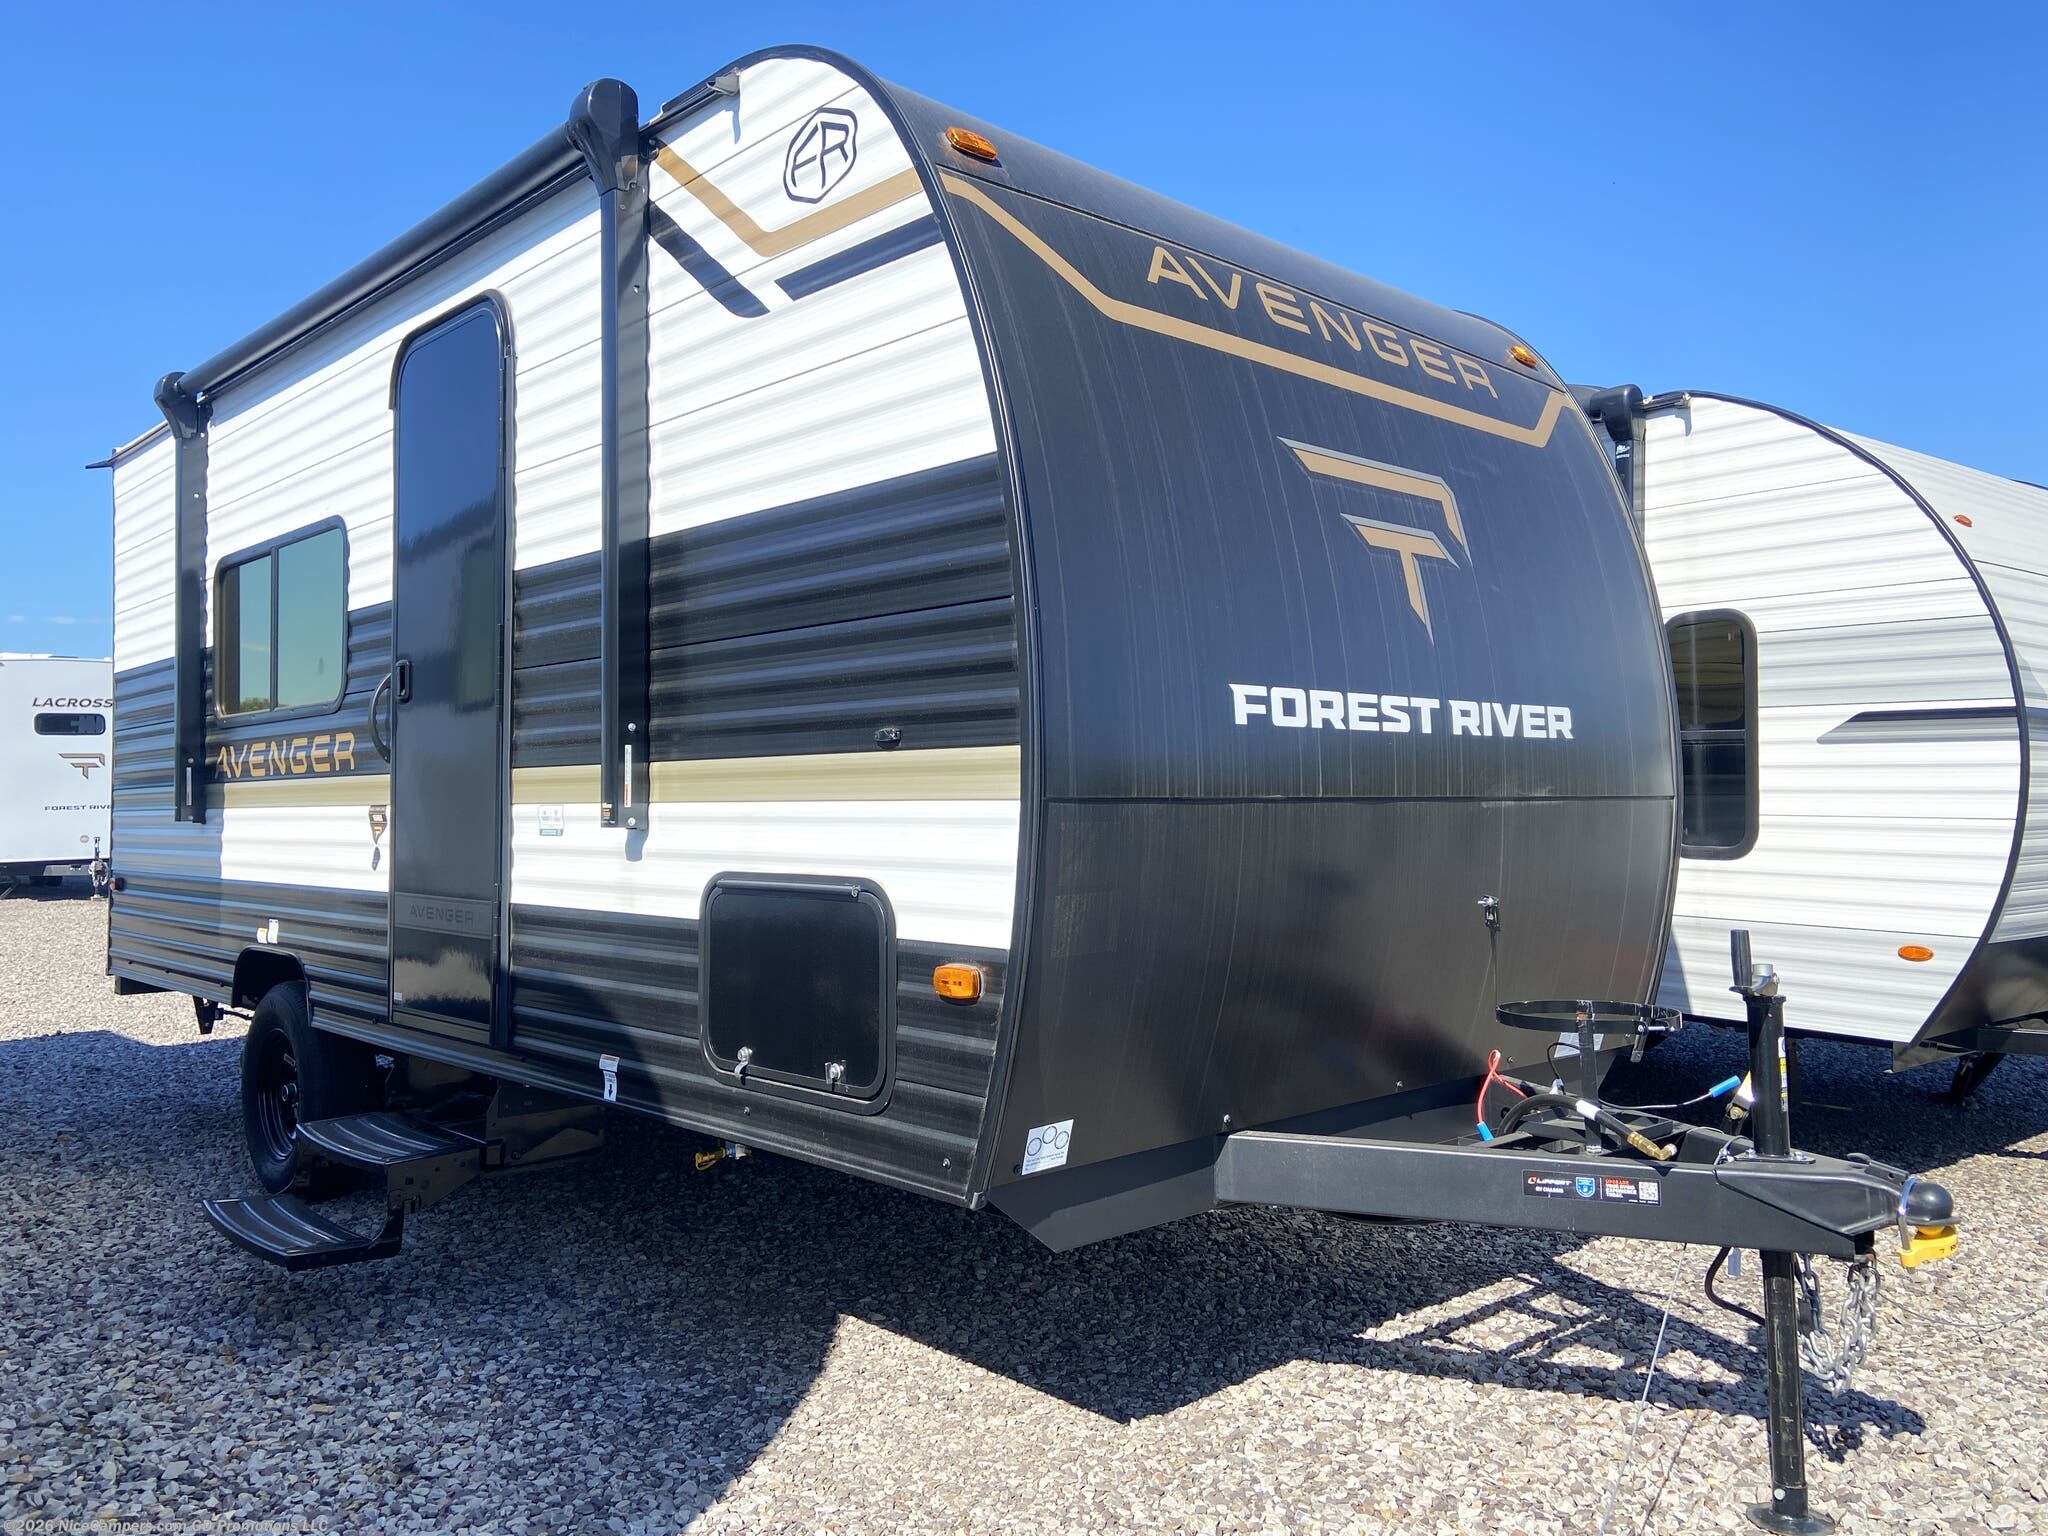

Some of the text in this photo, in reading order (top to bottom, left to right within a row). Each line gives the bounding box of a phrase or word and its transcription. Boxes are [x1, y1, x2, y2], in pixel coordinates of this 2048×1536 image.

[1147, 246, 1498, 399] AVENGER
[1229, 683, 1574, 739] FOREST RIVER
[215, 732, 355, 778] AVENGER
[410, 904, 474, 927] AVENGER
